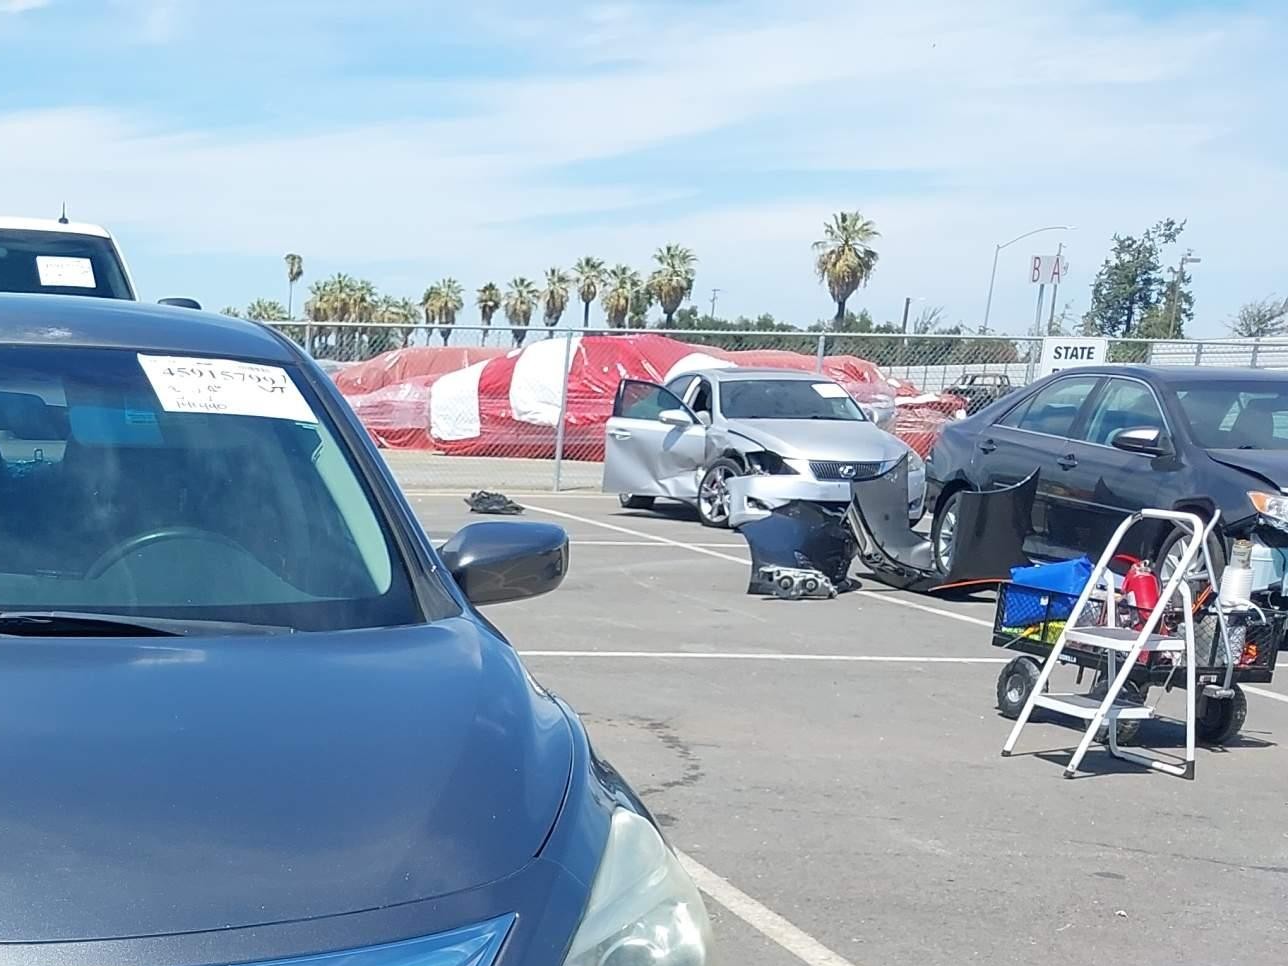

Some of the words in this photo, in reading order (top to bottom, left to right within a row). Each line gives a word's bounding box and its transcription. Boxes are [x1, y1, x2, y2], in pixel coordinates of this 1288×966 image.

[1032, 256, 1041, 282] B
[1051, 257, 1060, 283] A
[1053, 345, 1095, 360] STATE
